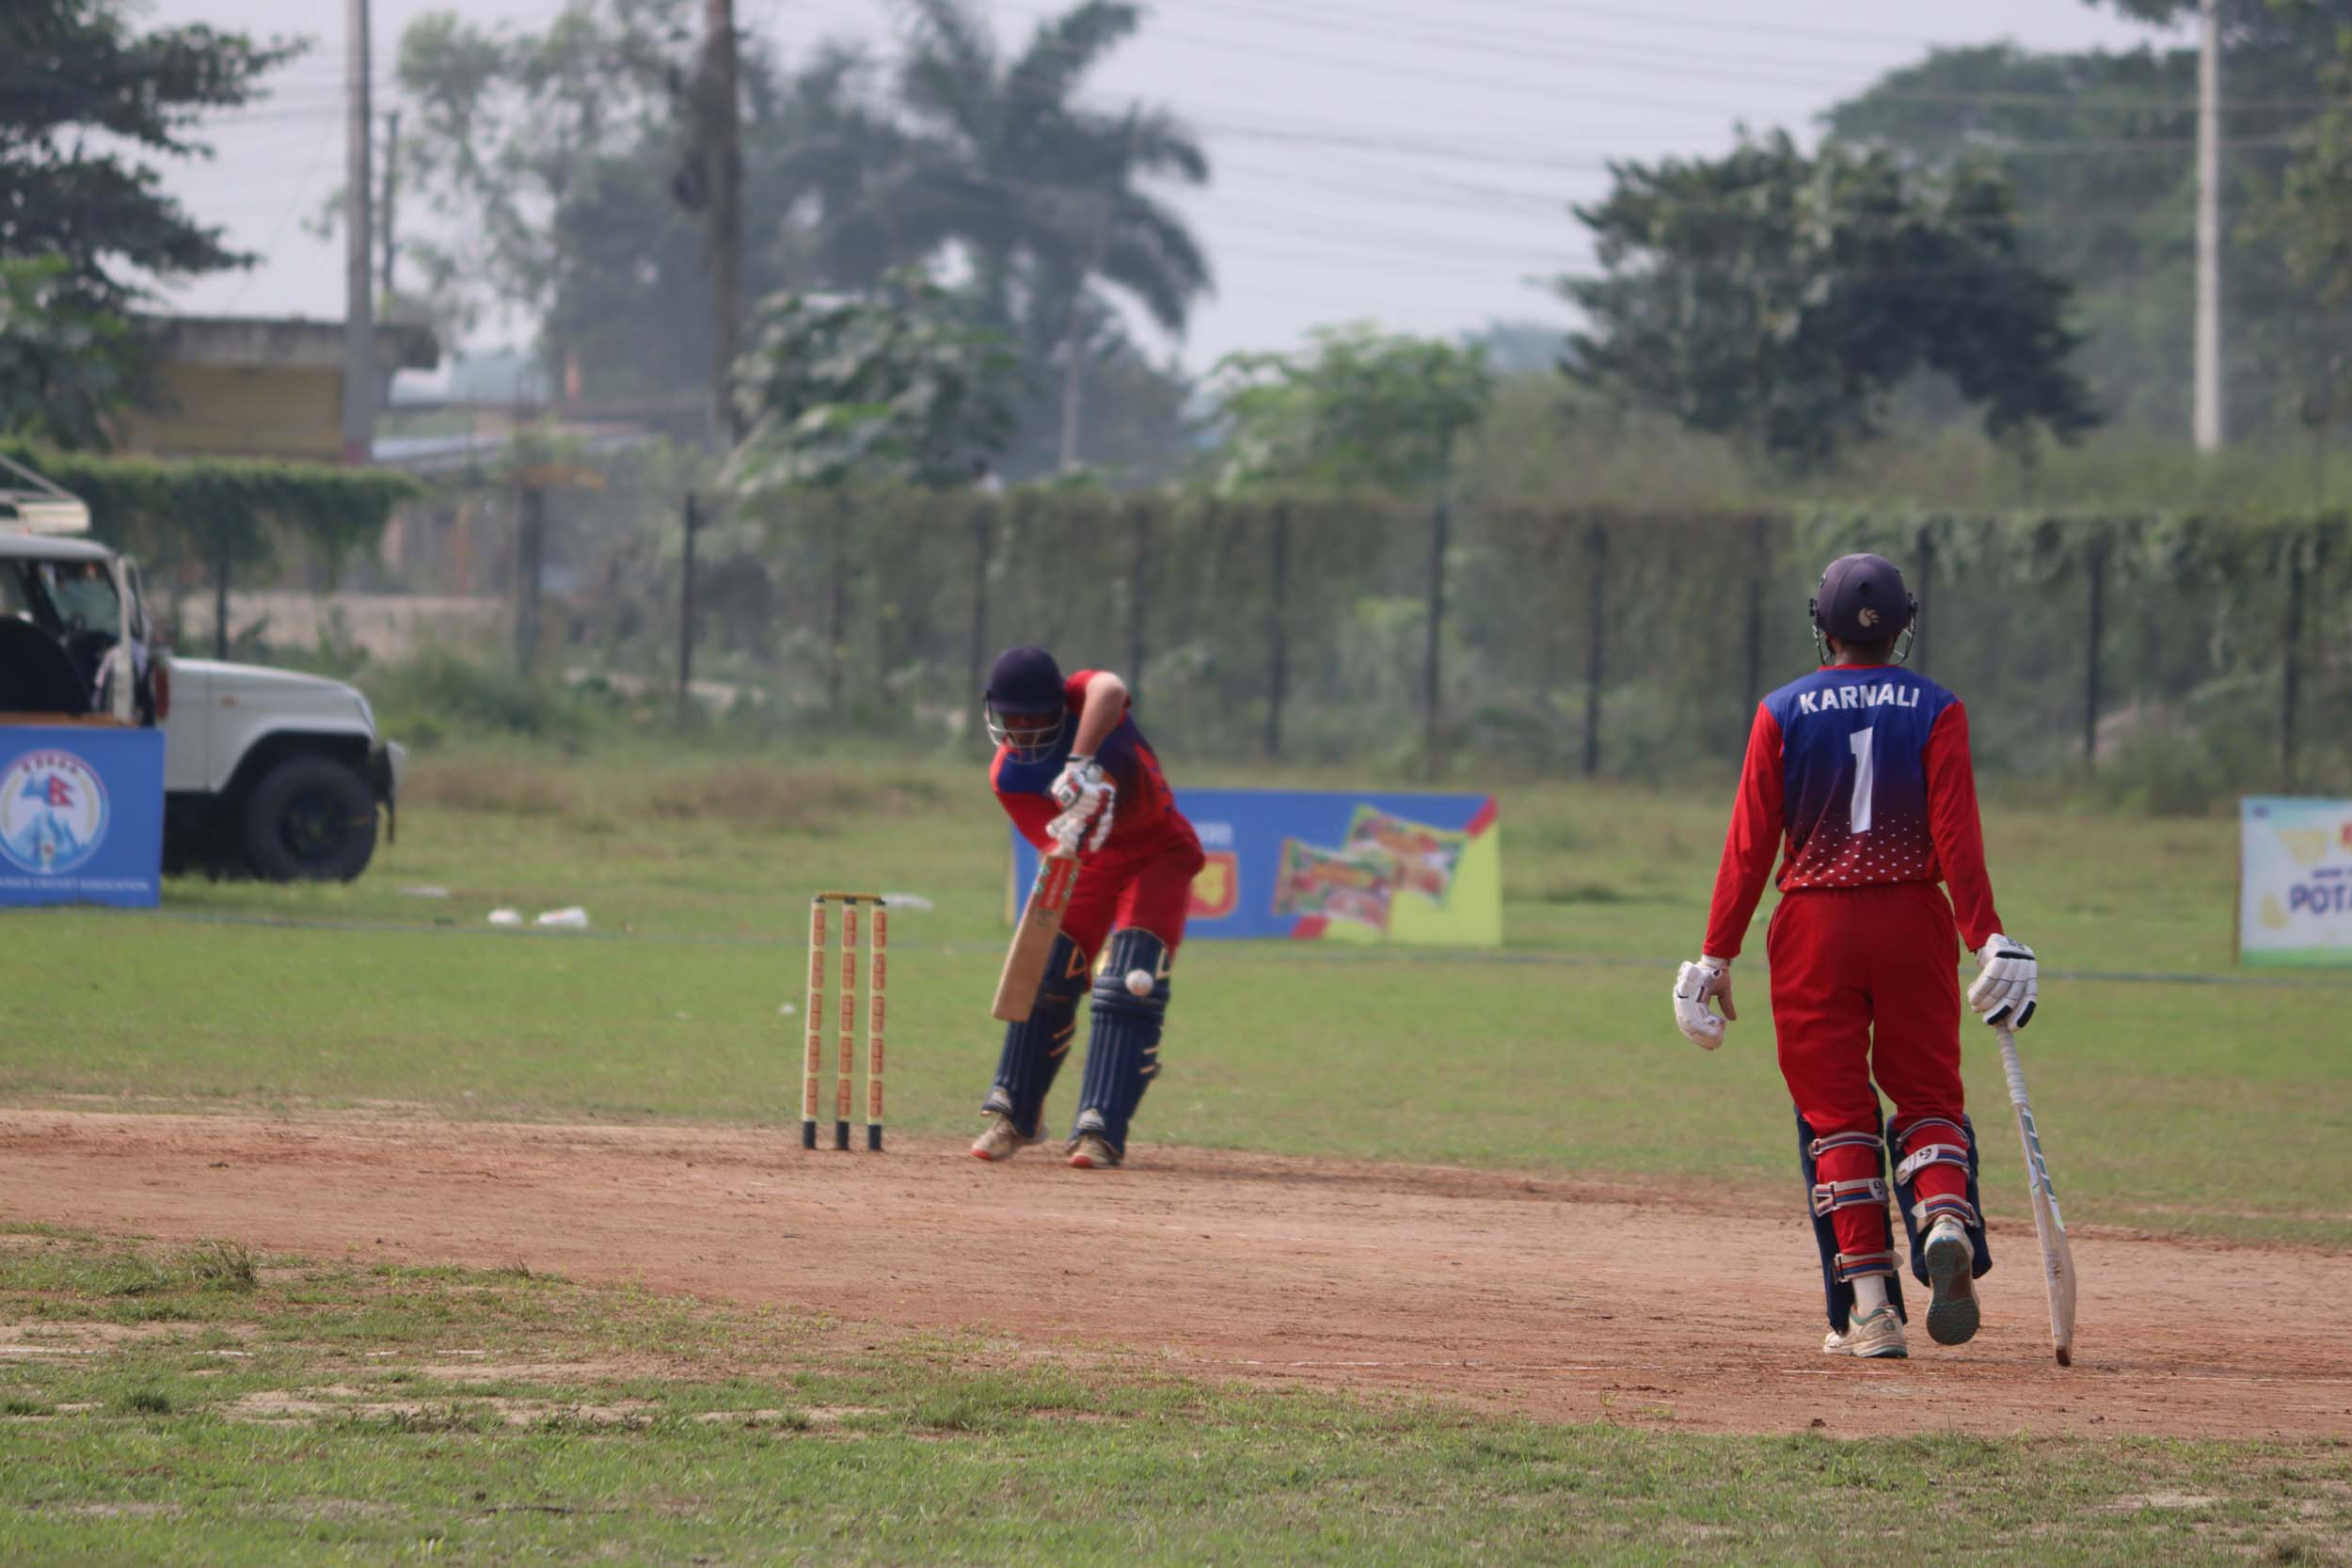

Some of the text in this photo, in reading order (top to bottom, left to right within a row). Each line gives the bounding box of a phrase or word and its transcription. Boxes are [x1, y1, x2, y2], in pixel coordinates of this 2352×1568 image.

[1799, 683, 1920, 715] KARNALI
[1850, 726, 1873, 834] 1
[2290, 883, 2352, 915] POT
